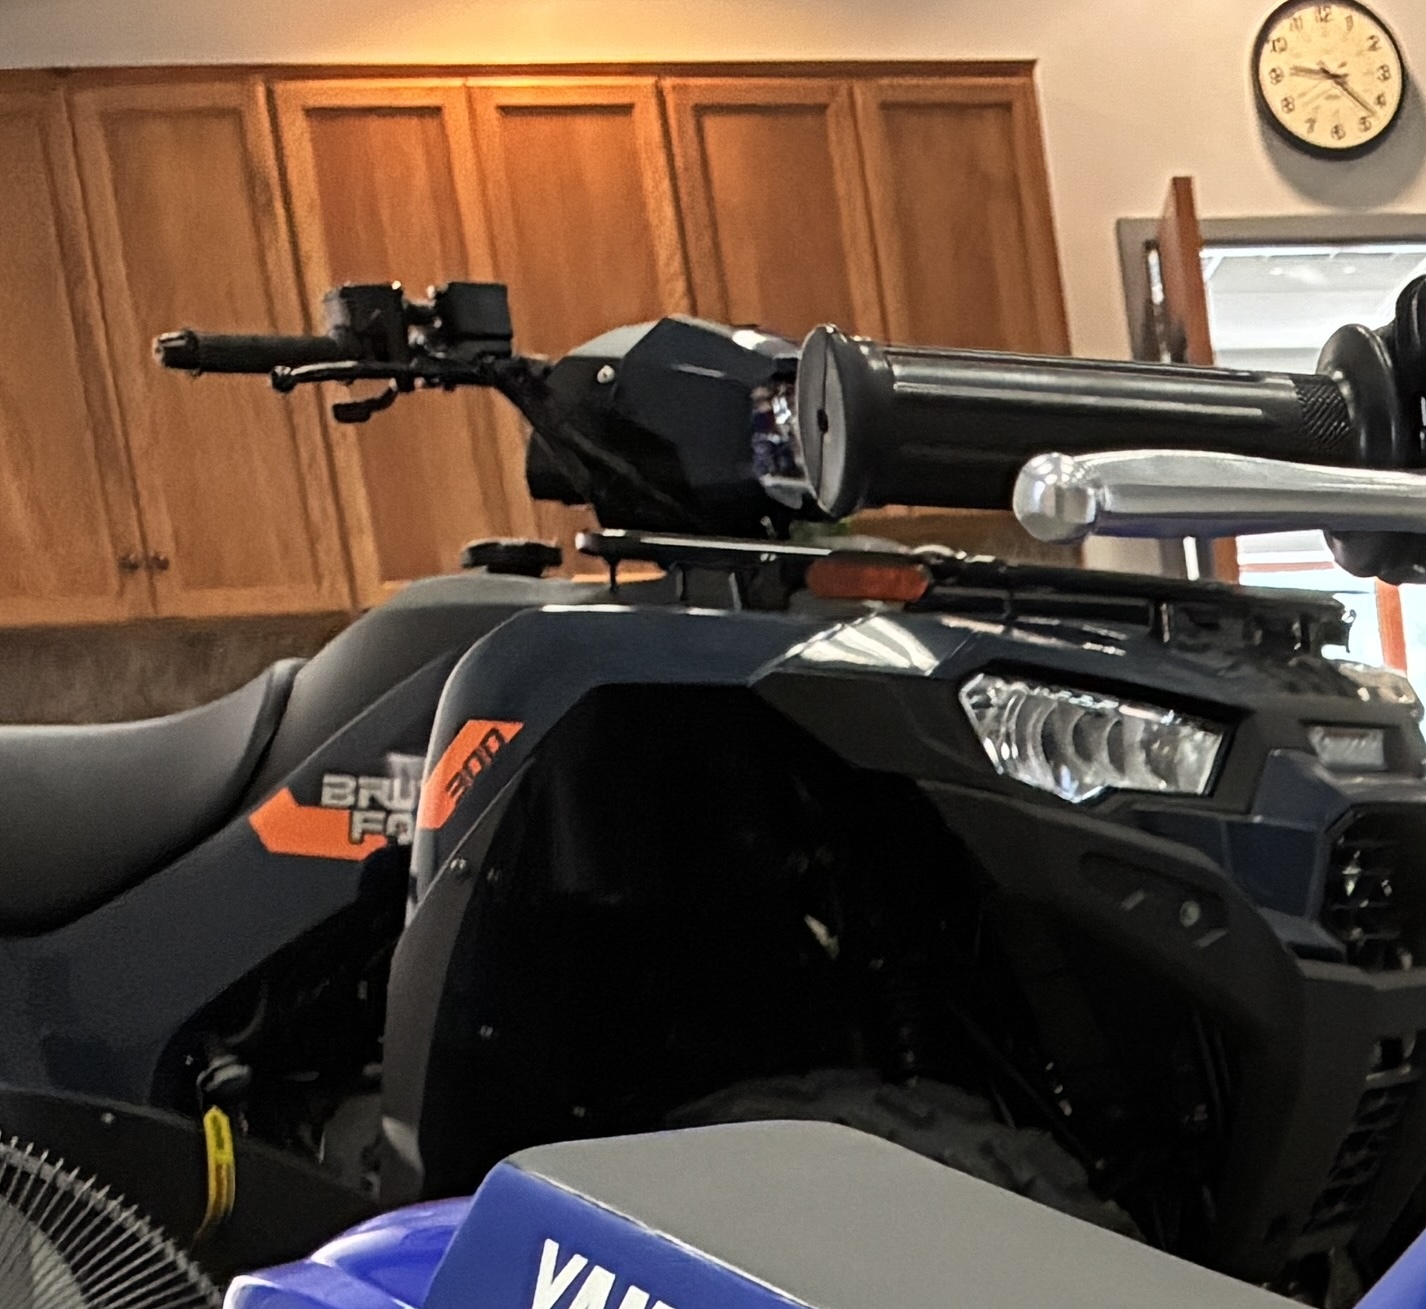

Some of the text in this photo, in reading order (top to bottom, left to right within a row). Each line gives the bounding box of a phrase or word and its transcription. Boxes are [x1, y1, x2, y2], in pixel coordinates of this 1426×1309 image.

[446, 728, 507, 800] 300
[320, 773, 422, 812] BRU
[351, 810, 416, 846] FO
